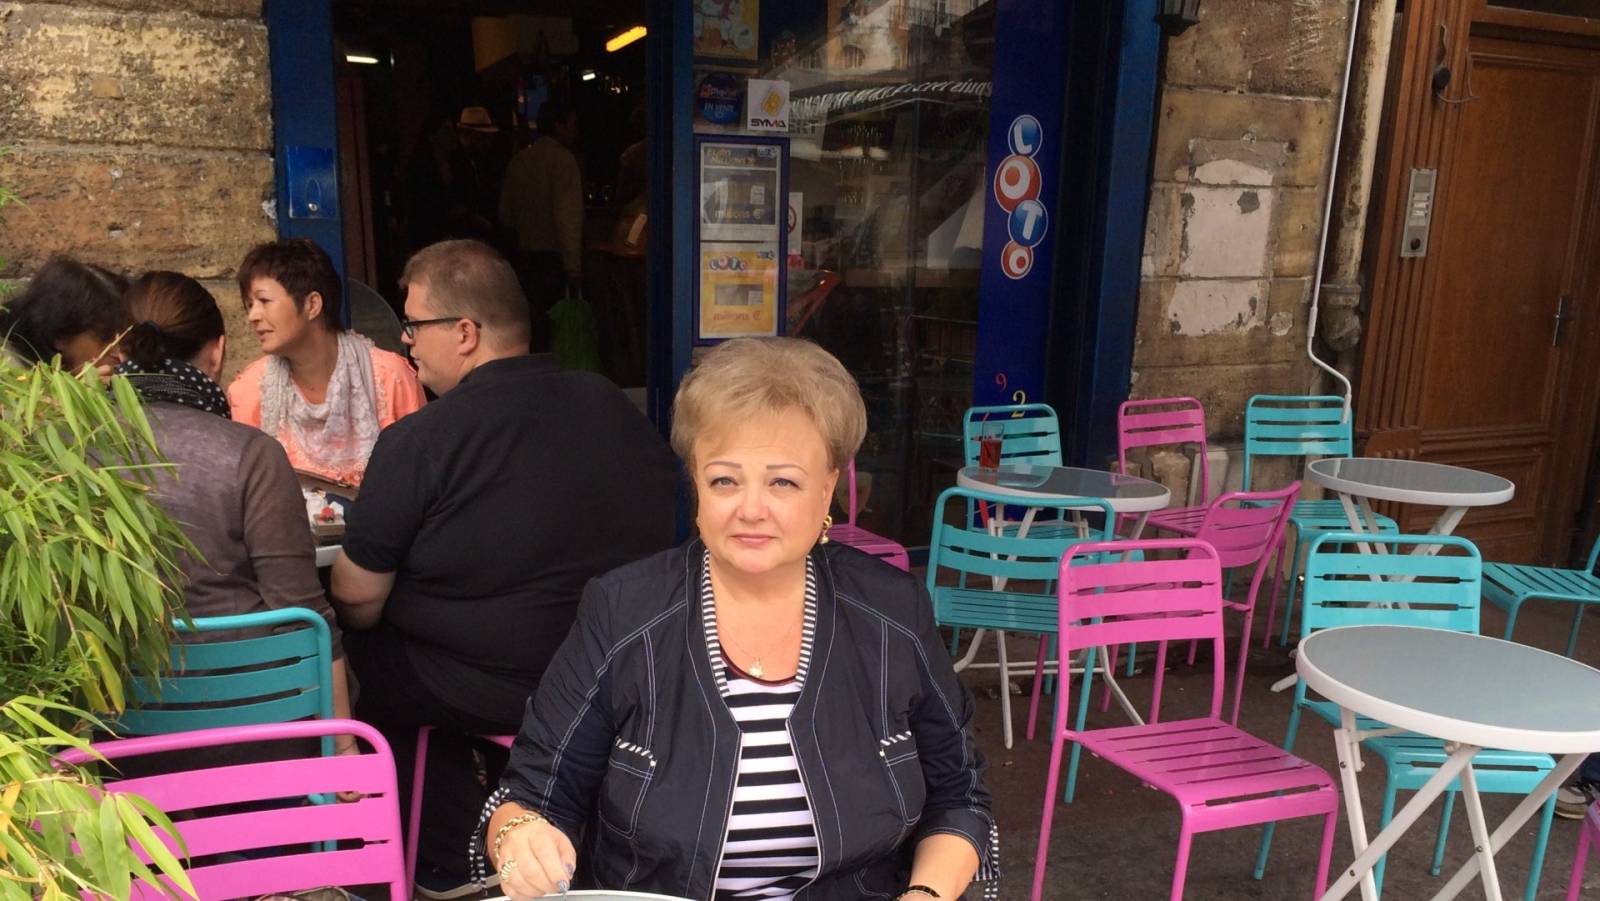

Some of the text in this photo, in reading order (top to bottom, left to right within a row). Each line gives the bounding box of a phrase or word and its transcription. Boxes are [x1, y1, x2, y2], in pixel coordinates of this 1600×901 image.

[750, 118, 786, 127] SYMA
[1000, 121, 1043, 274] LOTO
[1011, 390, 1026, 417] 2
